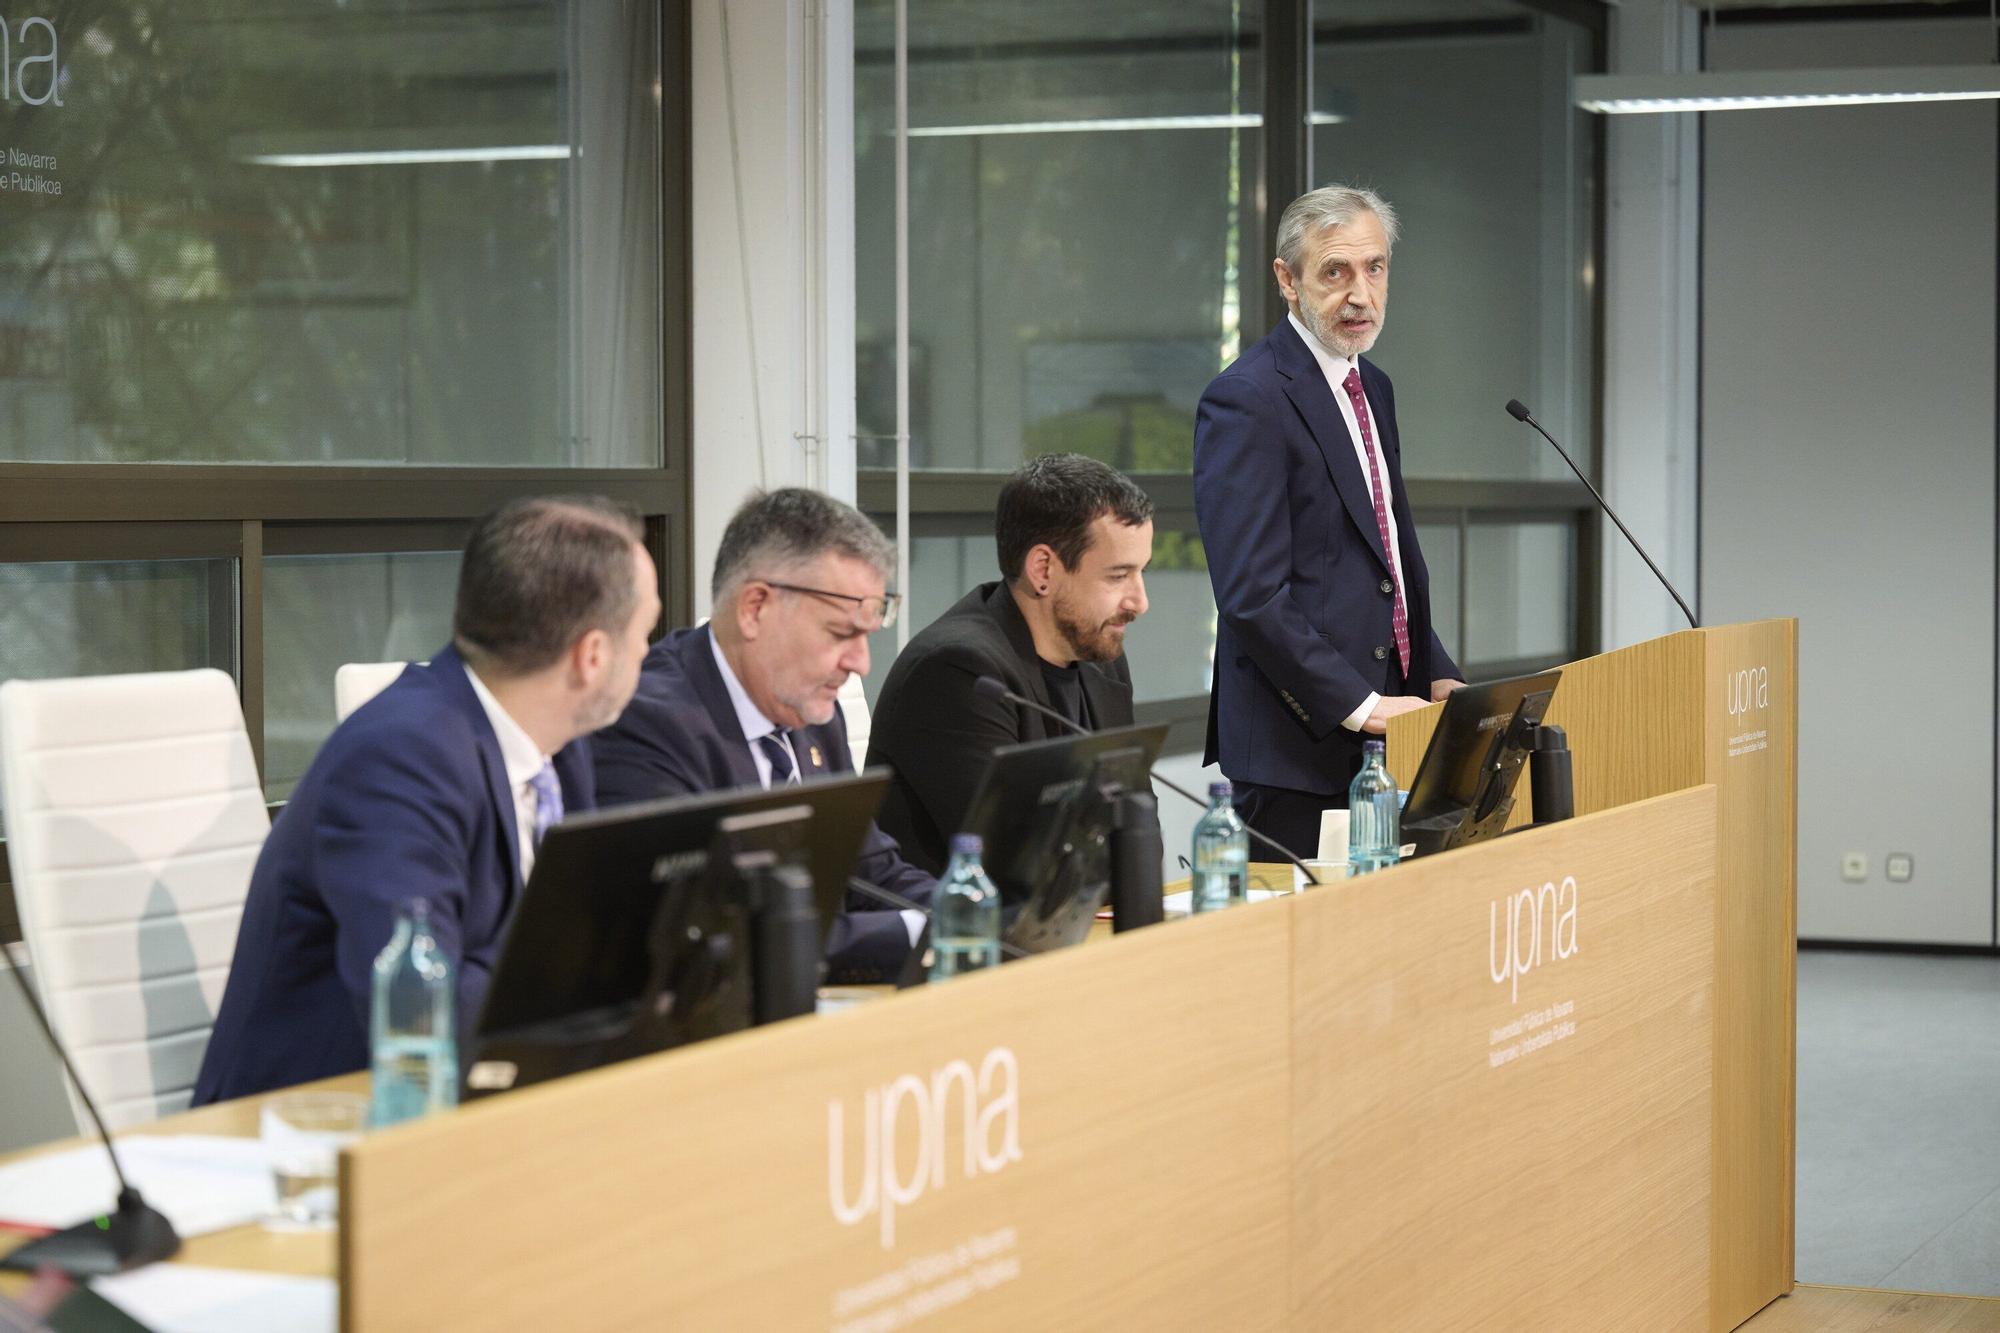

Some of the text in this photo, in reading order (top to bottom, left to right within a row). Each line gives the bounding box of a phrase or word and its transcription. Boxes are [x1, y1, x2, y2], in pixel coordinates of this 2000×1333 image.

[10, 147, 57, 170] Navarra
[11, 172, 62, 195] Publikoa
[1728, 666, 1768, 727] upna
[1490, 875, 1578, 1004] upna
[827, 1046, 1023, 1248] upna
